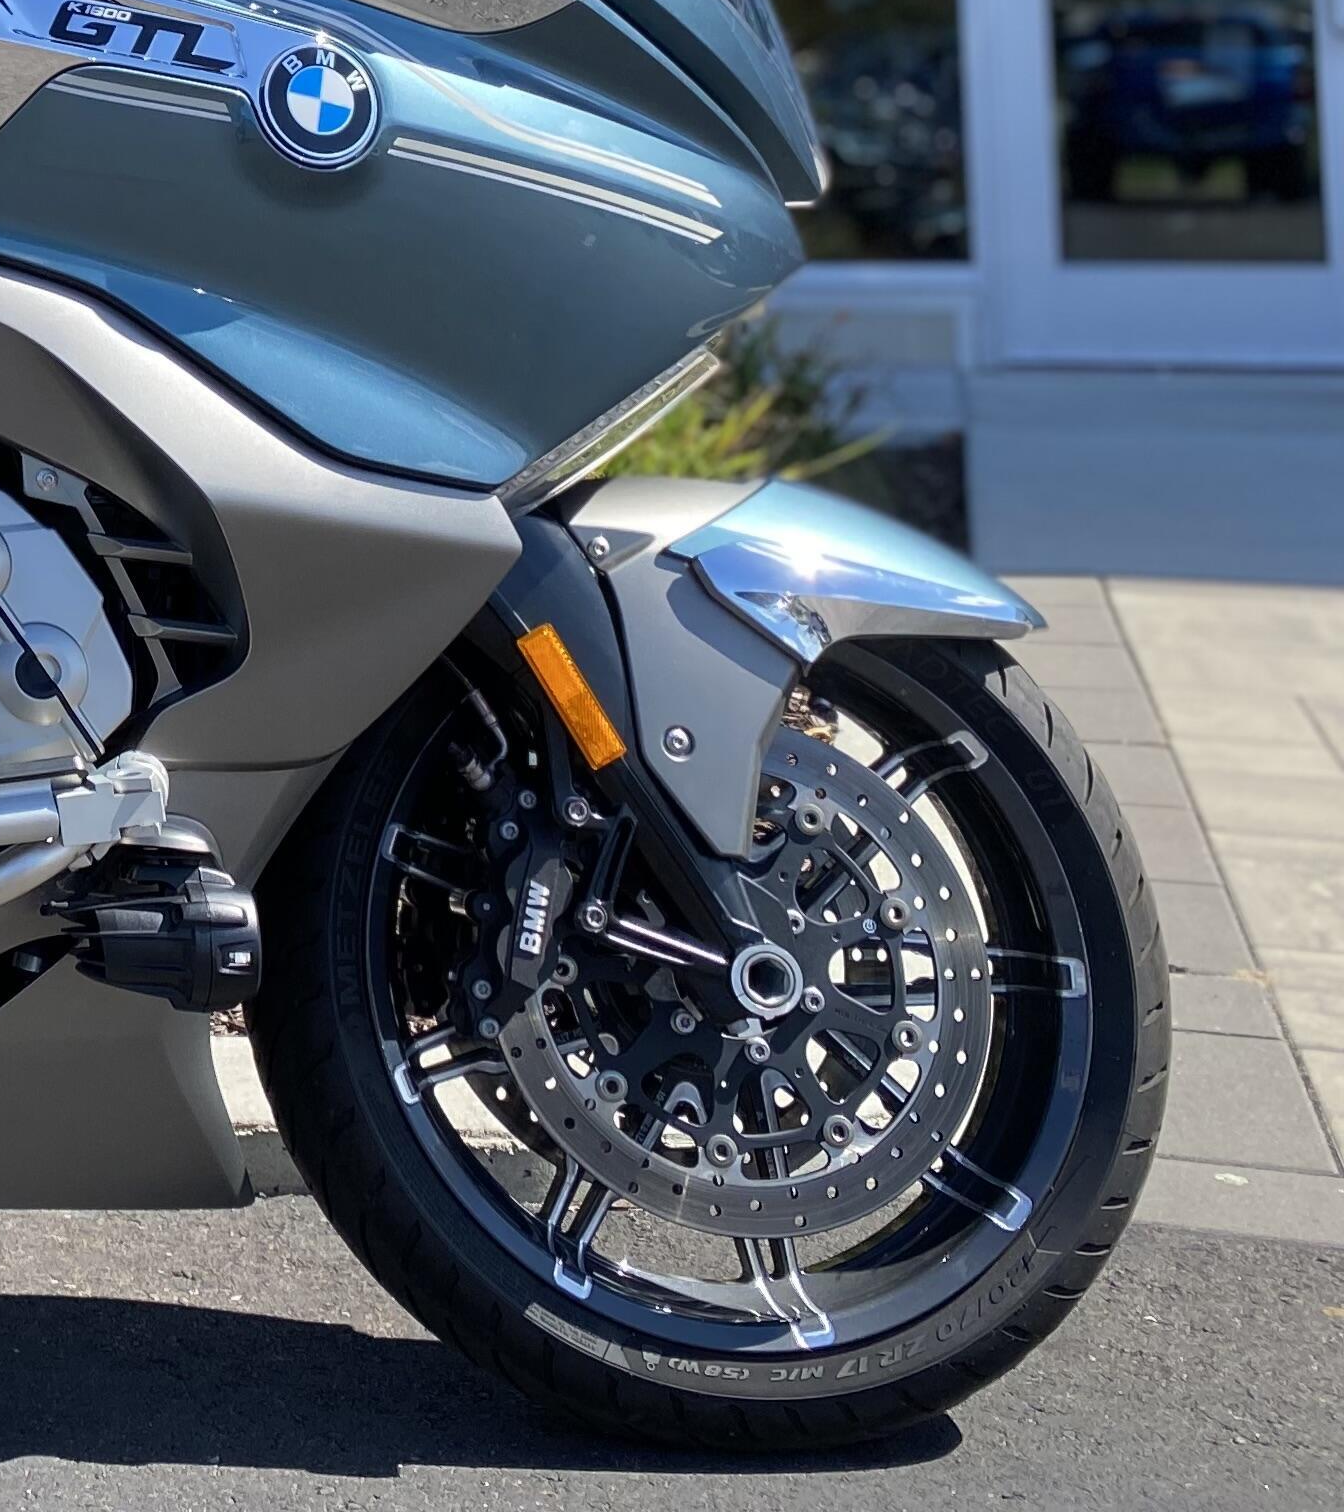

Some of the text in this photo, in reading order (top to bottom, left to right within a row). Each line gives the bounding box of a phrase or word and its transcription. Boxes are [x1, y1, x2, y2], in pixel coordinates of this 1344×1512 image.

[49, 0, 236, 73] GTL
[281, 48, 368, 93] BMW
[519, 879, 551, 956] BMW
[835, 1356, 870, 1381] 17
[878, 1340, 929, 1369] ZR
[769, 1365, 825, 1382] M/C
